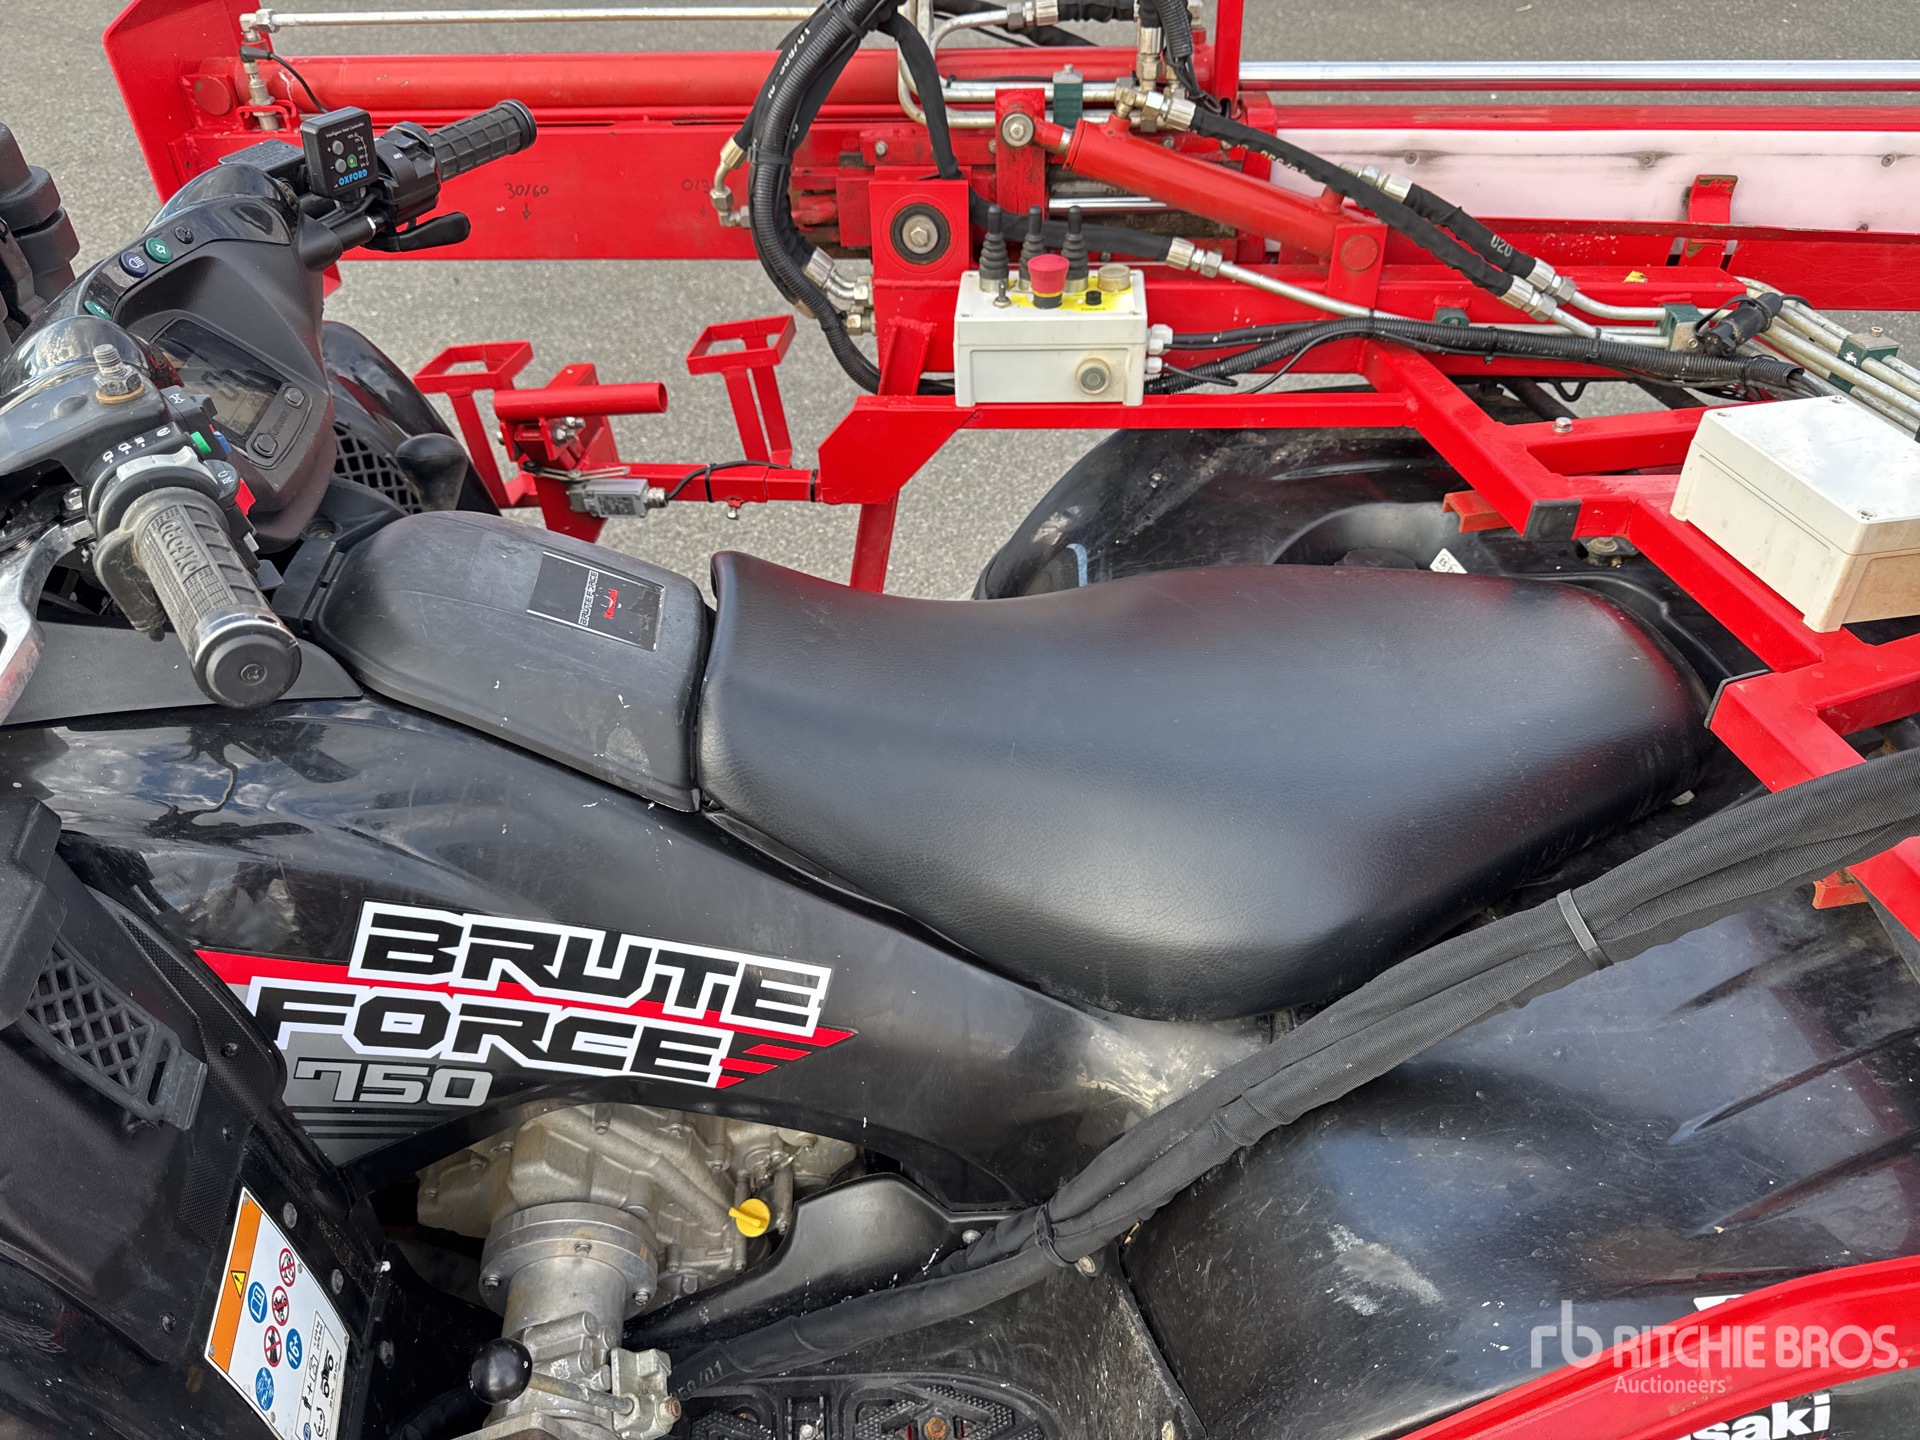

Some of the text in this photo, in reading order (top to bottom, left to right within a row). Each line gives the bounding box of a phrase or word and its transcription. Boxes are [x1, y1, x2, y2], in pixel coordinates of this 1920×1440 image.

[338, 168, 368, 186] OXFORD
[578, 596, 594, 626] BRUTE
[348, 901, 833, 1037] BRUTE
[247, 976, 735, 1089] FORCE
[294, 1058, 493, 1107] 750
[287, 1334, 300, 1366] 16+
[1683, 1393, 1831, 1440] saki
